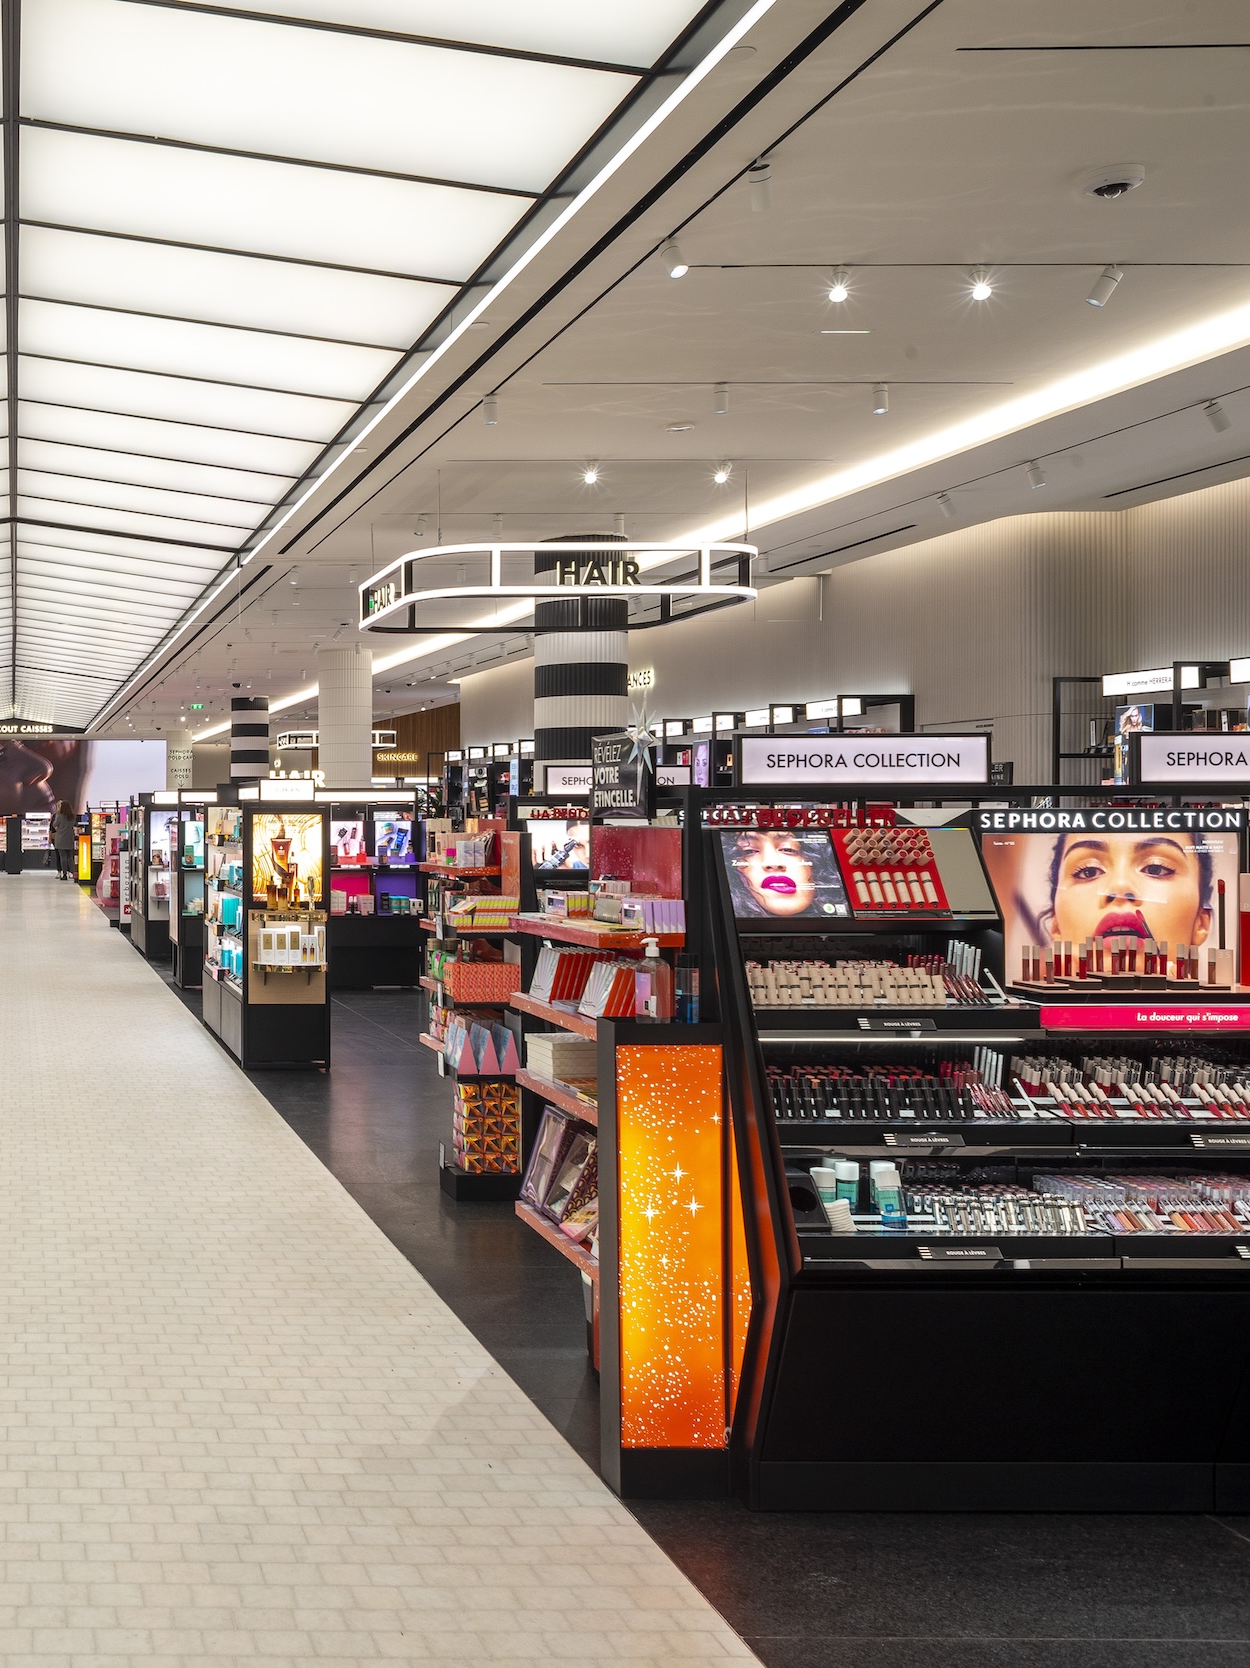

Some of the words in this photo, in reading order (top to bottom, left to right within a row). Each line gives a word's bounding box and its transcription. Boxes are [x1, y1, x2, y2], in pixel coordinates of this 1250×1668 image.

[556, 560, 640, 586] HAIR
[374, 583, 395, 613] HAIR
[627, 670, 652, 688] ANCES
[1149, 676, 1172, 685] HERRERA
[20, 725, 53, 733] CAISSES
[376, 753, 419, 762] SKINCARE
[594, 742, 621, 764] RÉVÉLEZ
[766, 753, 847, 768] SEPHORA
[853, 753, 960, 768] COLLECTION
[1166, 751, 1249, 767] SEPHORA
[561, 776, 593, 786] SEPHO
[594, 766, 619, 784] VOTRE
[594, 787, 636, 808] ÉTINCELLE.
[981, 812, 1086, 829] SEPHORA
[1092, 811, 1241, 829] COLLECTION
[1137, 1012, 1148, 1021] La
[1149, 1011, 1184, 1021] douceur
[1186, 1012, 1200, 1023] qui
[1202, 1012, 1239, 1023] s'impose
